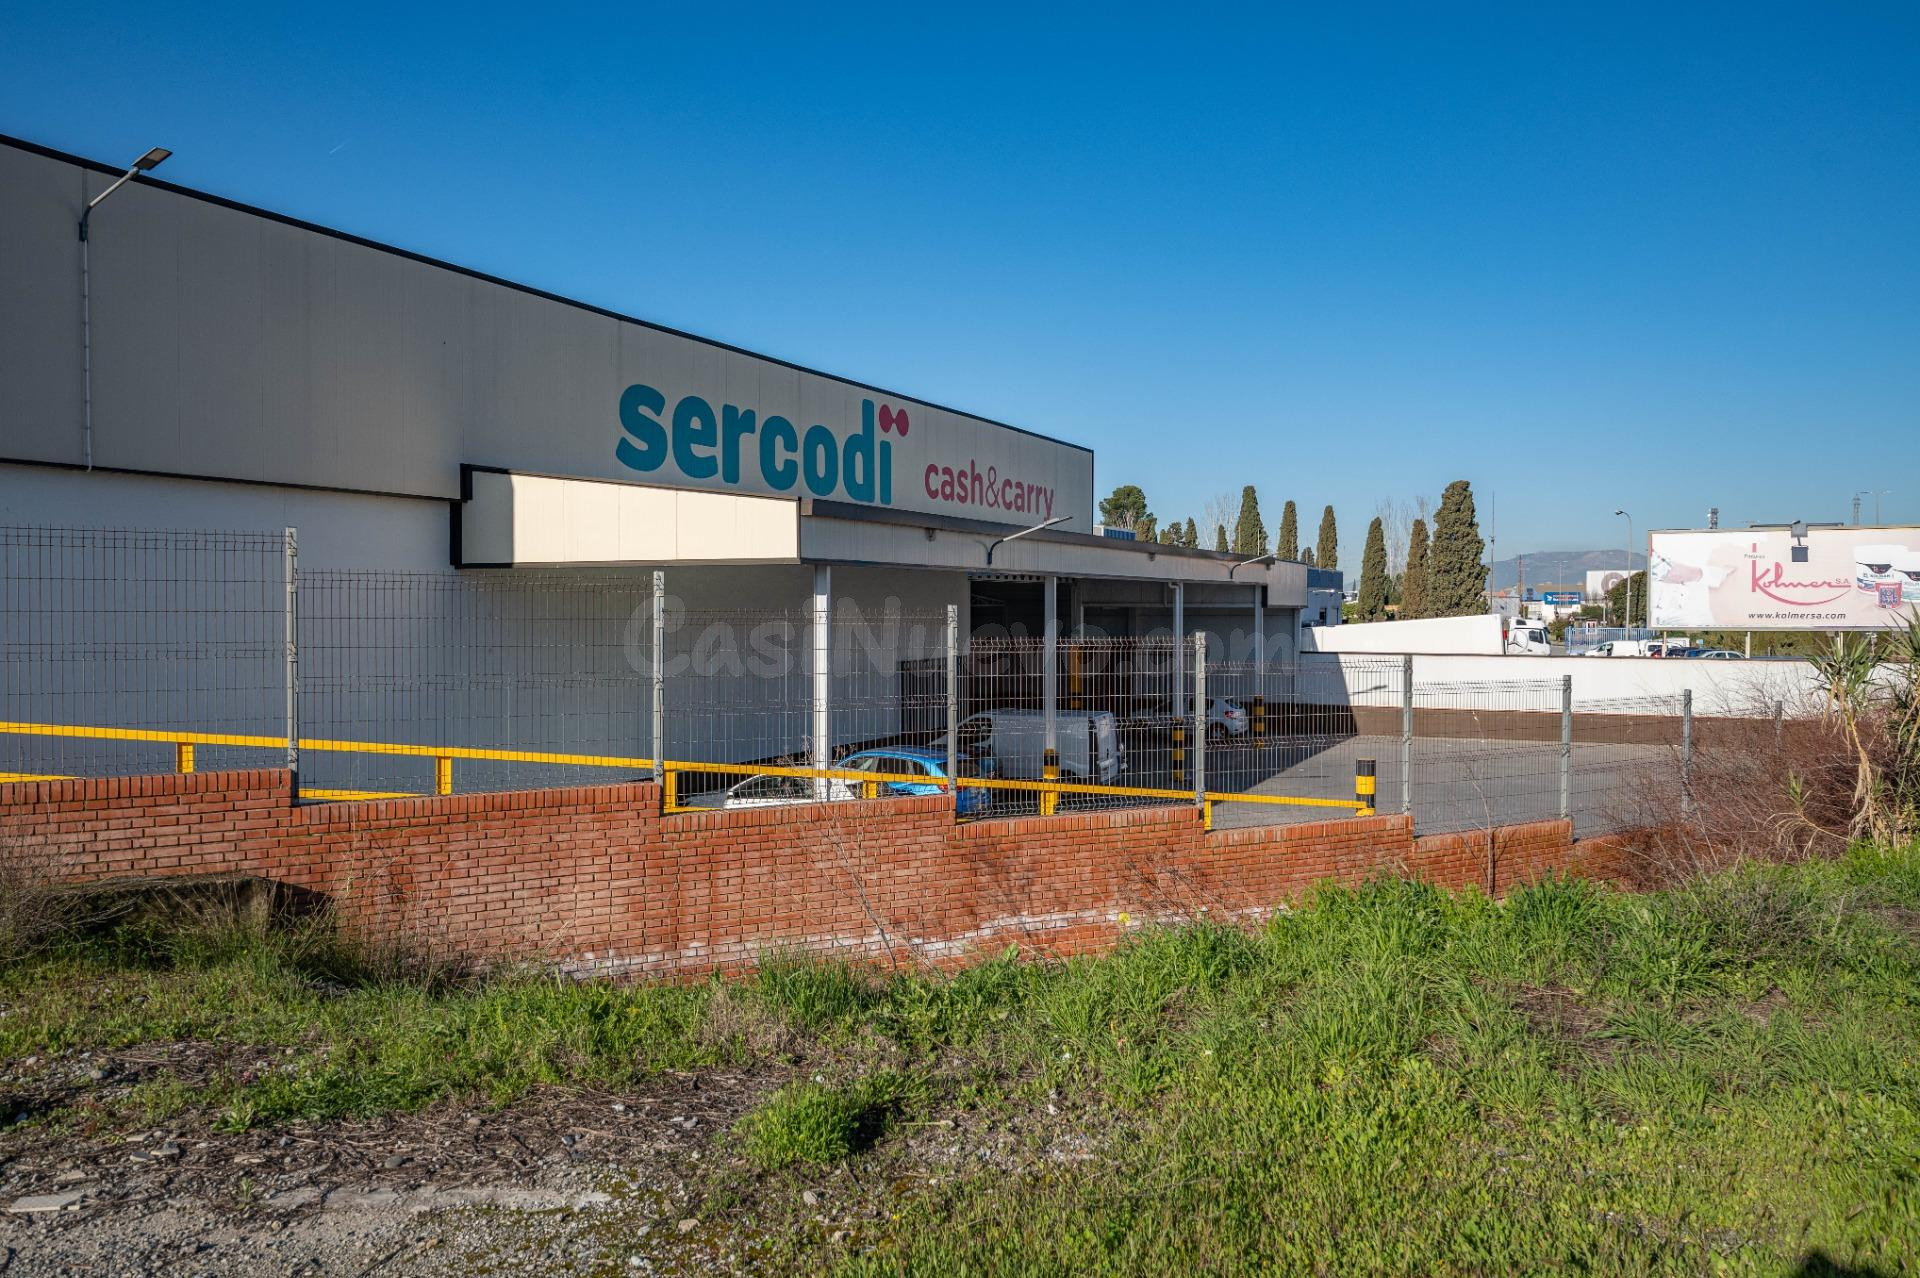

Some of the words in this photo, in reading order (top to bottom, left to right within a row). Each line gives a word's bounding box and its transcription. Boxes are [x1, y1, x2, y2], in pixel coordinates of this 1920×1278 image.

[924, 458, 1054, 521] cash&carry
[1751, 543, 1852, 605] Kolmer
[1748, 611, 1847, 620] www.kolmersa.com
